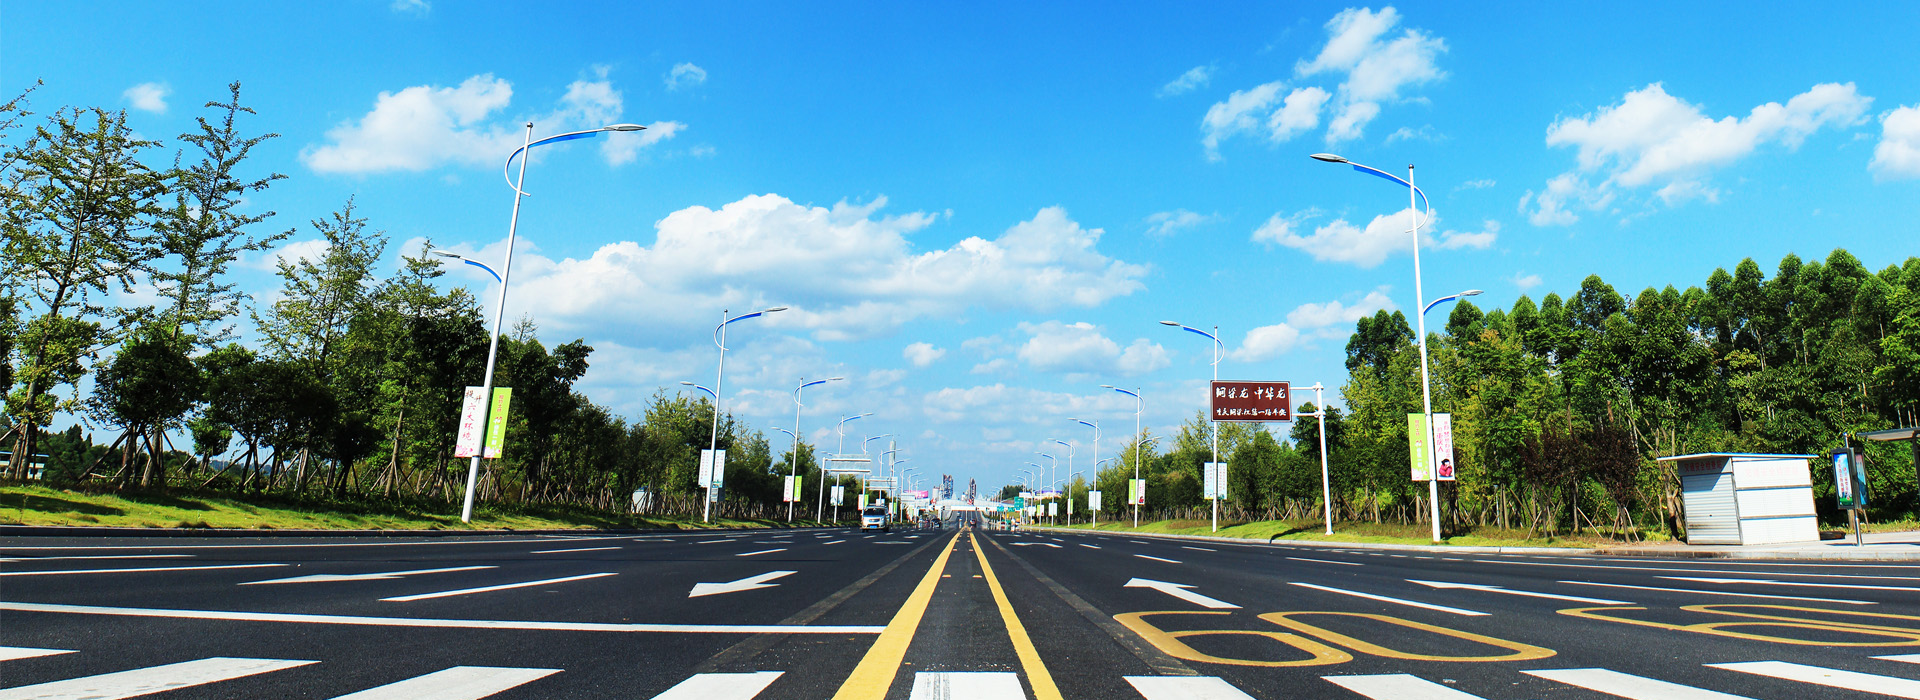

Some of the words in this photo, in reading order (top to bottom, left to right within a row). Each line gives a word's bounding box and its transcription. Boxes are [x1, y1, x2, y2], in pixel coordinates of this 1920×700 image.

[1215, 386, 1250, 399] 铜梁龙
[1253, 386, 1287, 401] 中华龙
[1112, 611, 1558, 668] 60
